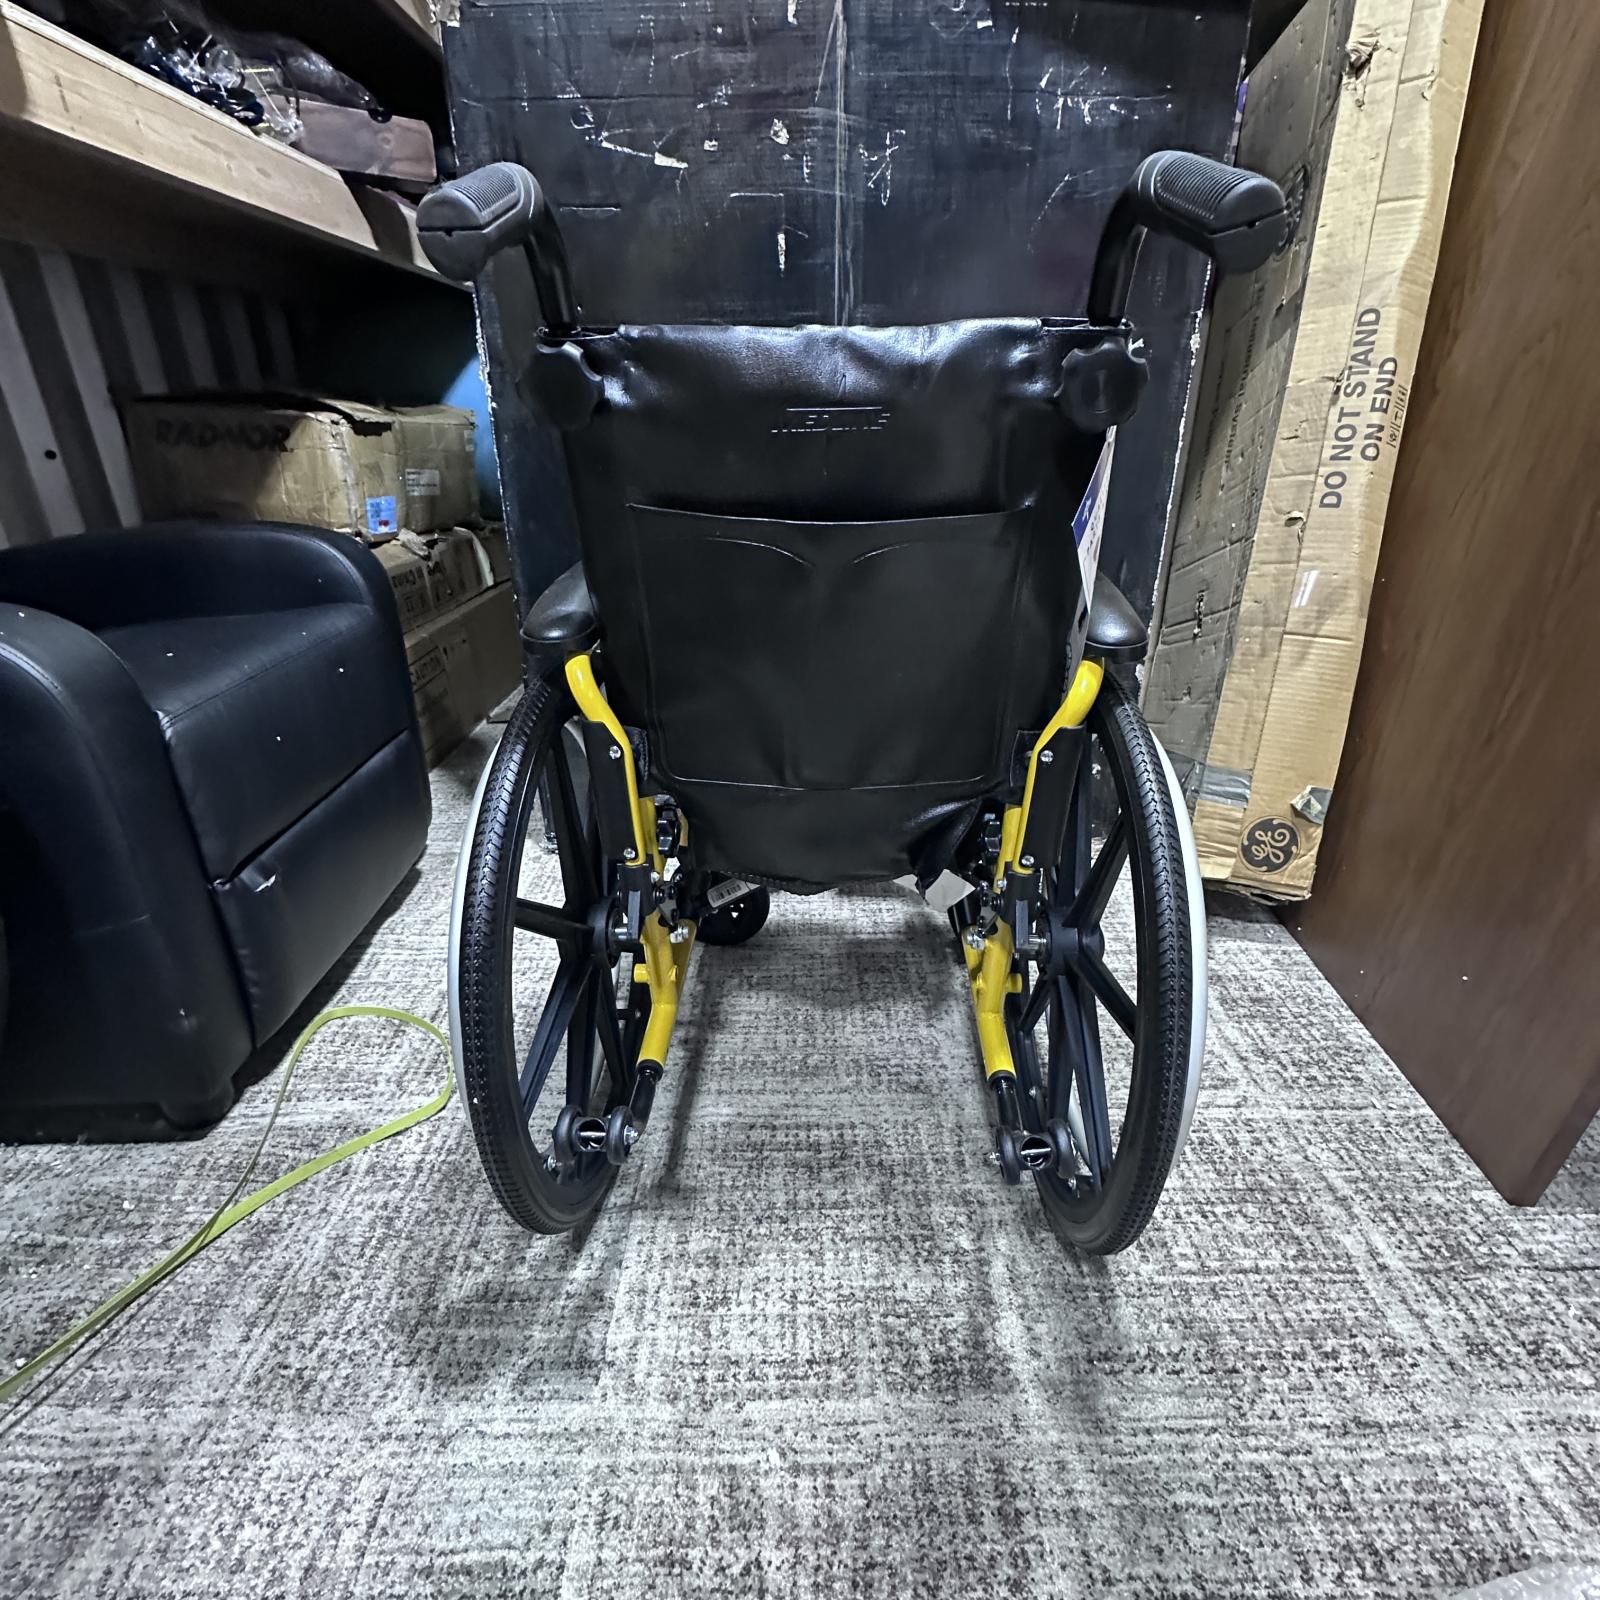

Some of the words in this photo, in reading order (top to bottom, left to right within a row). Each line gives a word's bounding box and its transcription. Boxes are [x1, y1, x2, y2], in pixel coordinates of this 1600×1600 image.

[1343, 307, 1381, 398] STAND
[1369, 356, 1398, 415] END
[1329, 406, 1361, 461] NOT
[1360, 423, 1385, 462] ON
[1319, 471, 1347, 509] DO
